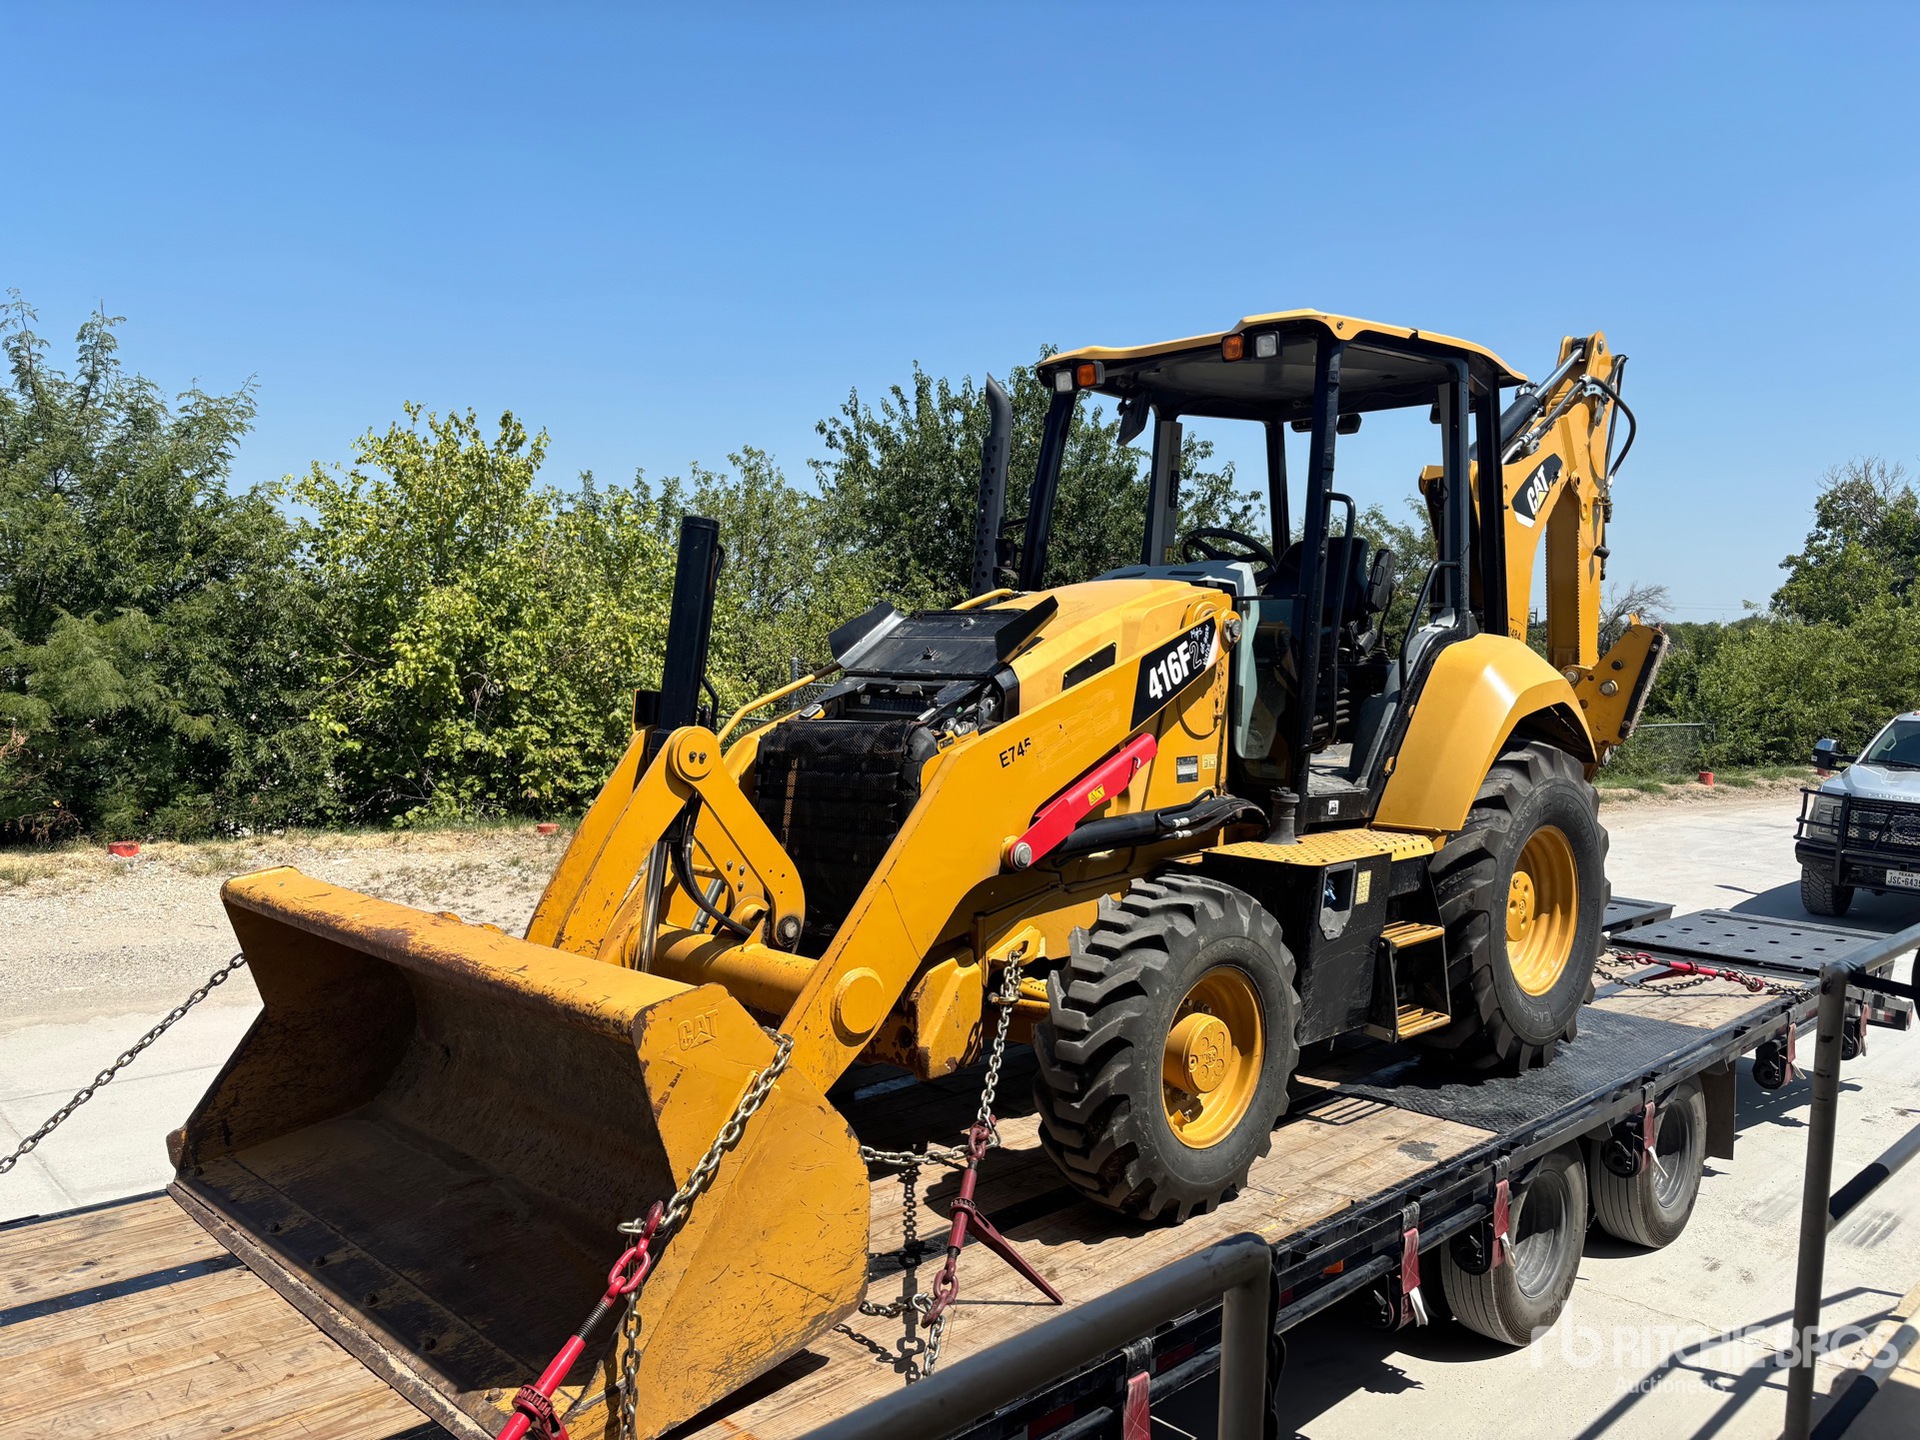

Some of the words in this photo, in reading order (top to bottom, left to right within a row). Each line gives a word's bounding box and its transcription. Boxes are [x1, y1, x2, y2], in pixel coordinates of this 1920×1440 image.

[1527, 464, 1549, 516] CAT
[1887, 876, 1920, 887] JSC-643
[678, 1008, 718, 1051] CAT
